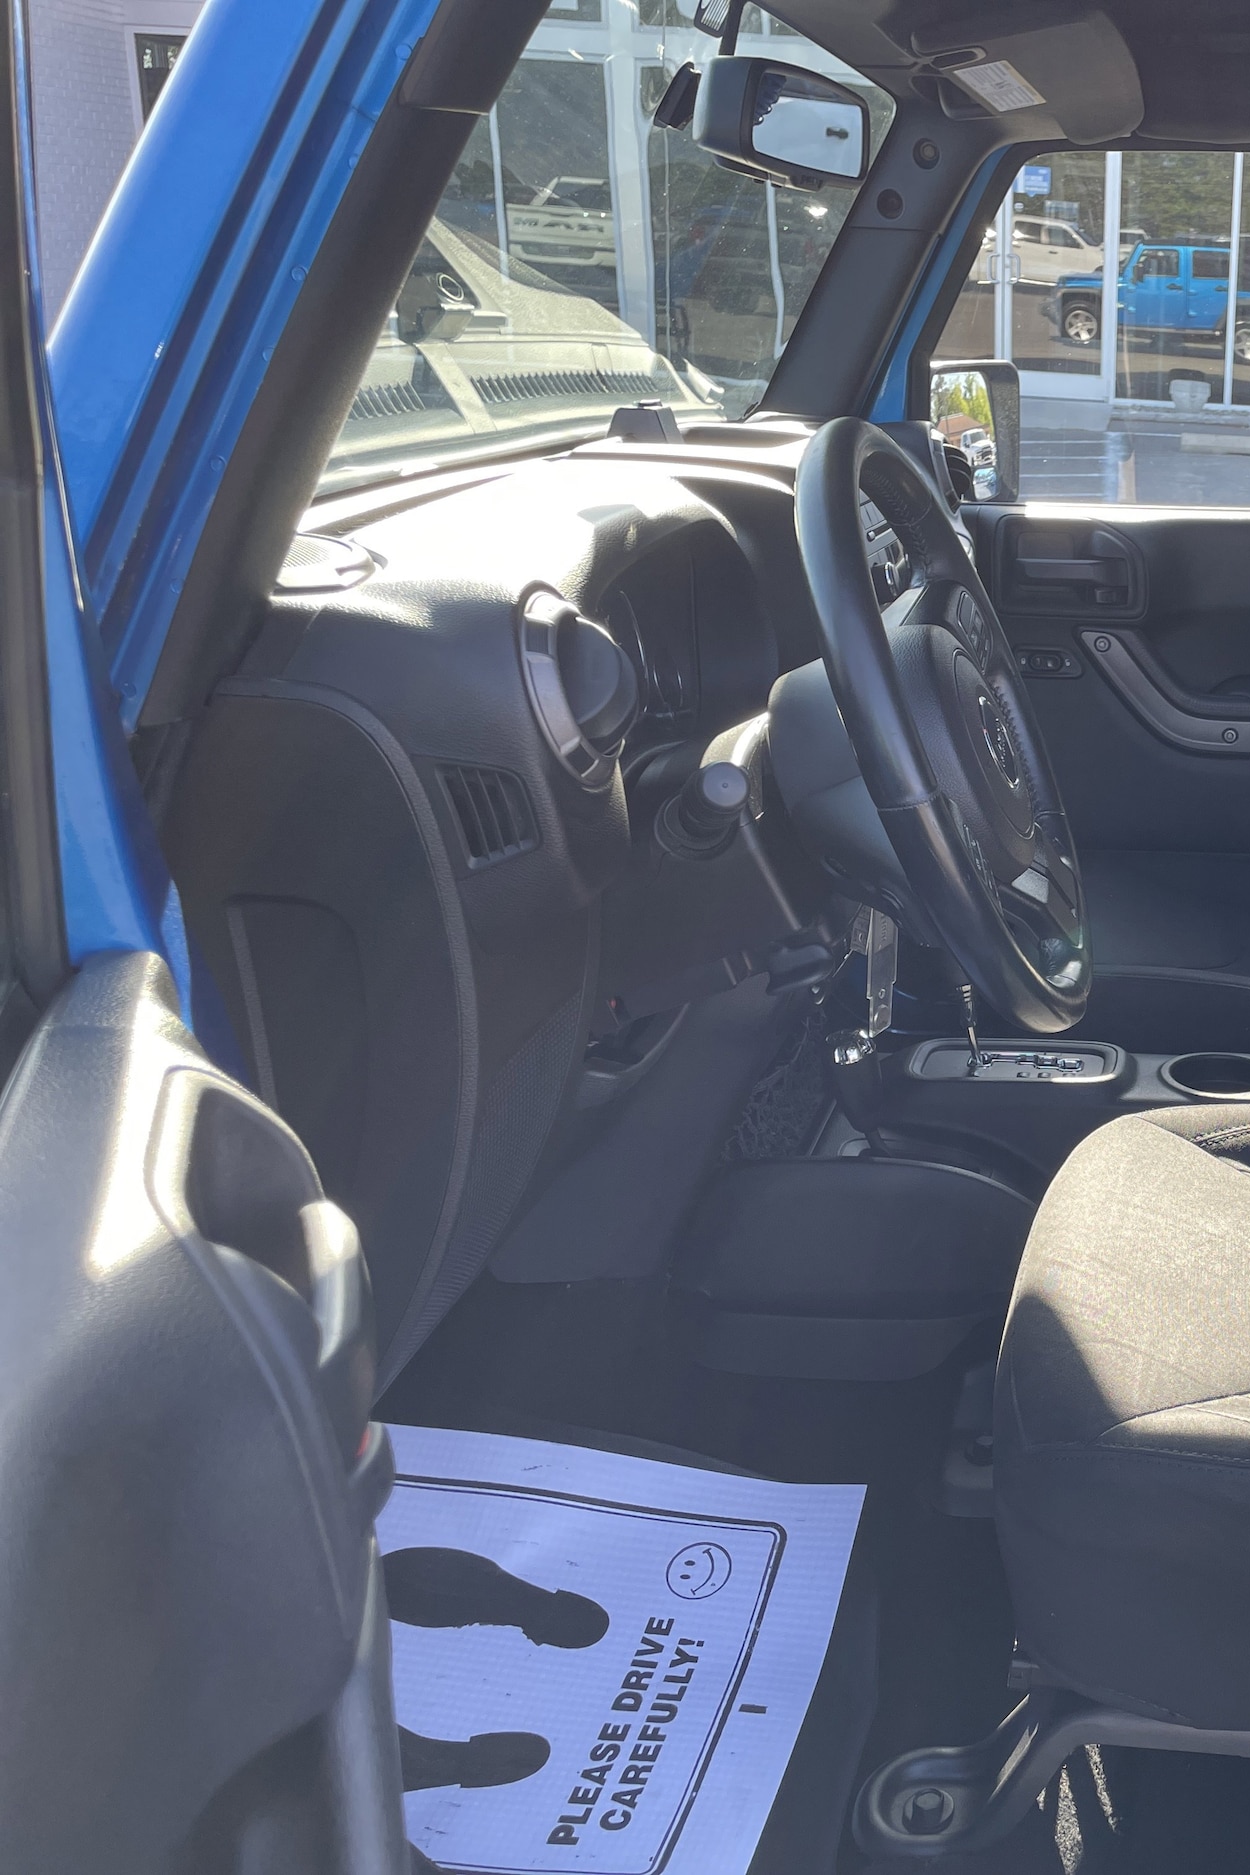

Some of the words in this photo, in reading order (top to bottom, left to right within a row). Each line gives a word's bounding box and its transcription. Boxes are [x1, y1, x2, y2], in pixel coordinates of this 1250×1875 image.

[546, 1723, 631, 1845] PLEASE
[610, 1617, 675, 1712] DRIVE
[599, 1638, 705, 1832] CAREFULLY!
